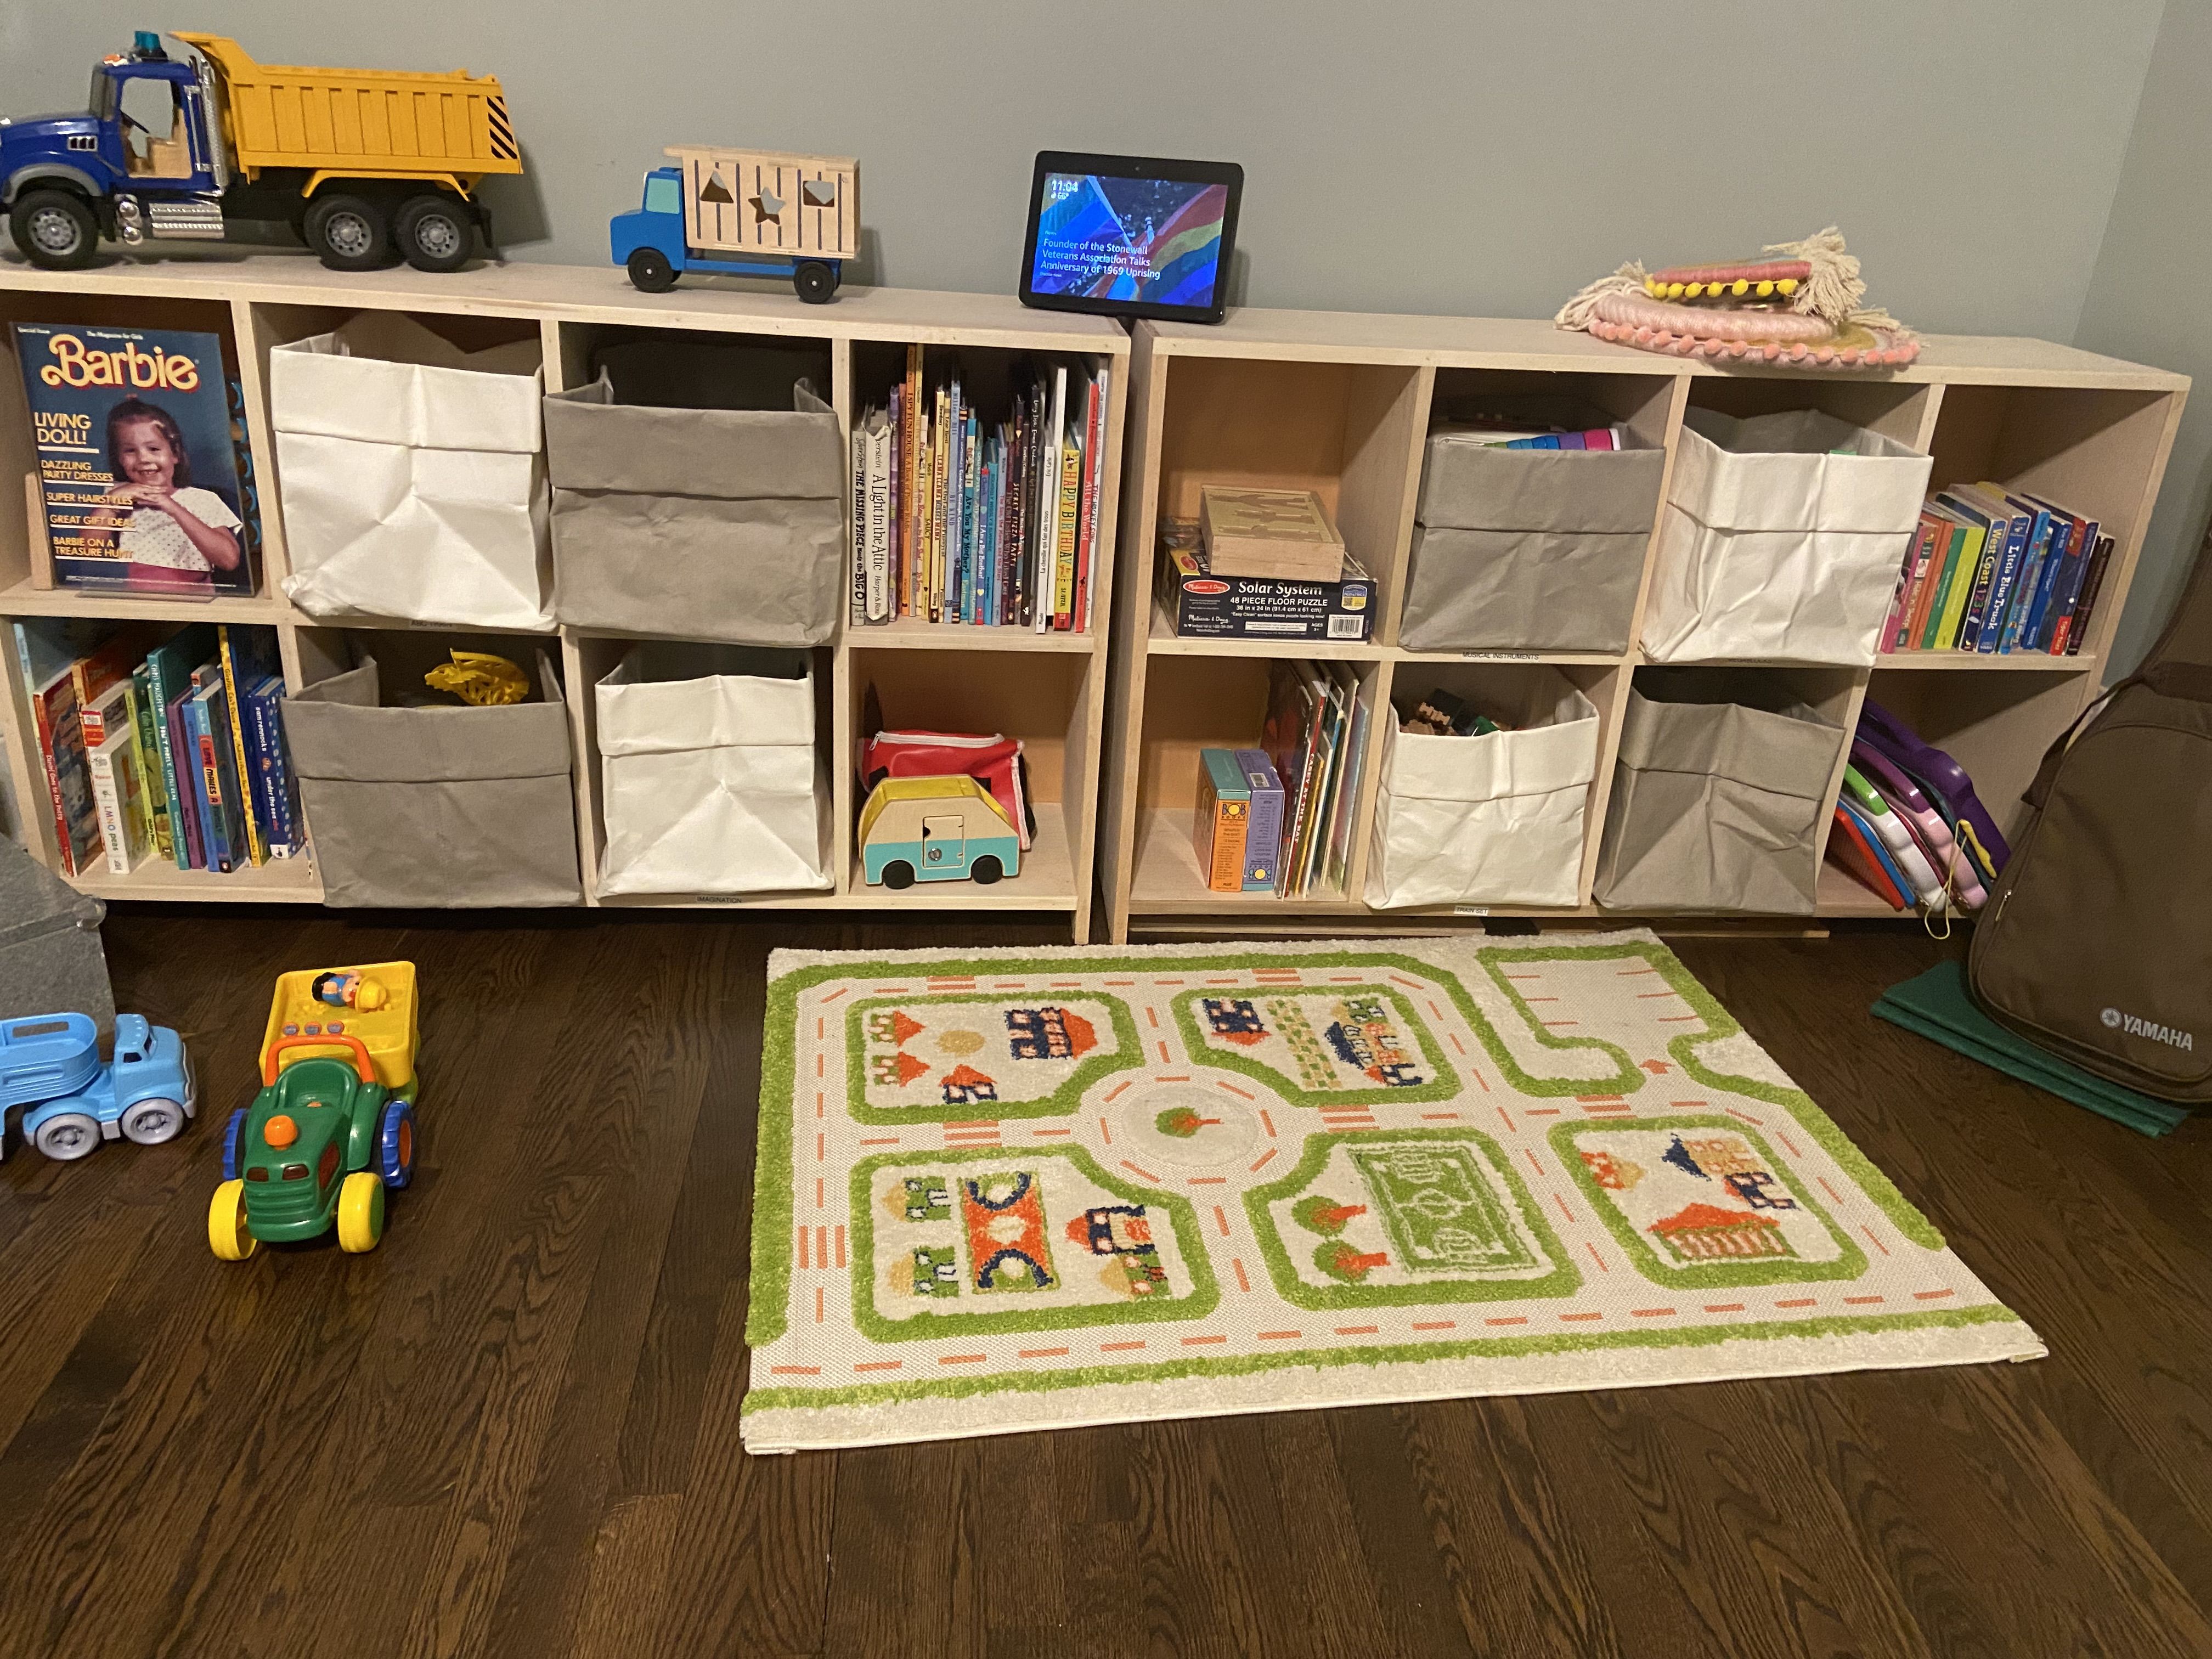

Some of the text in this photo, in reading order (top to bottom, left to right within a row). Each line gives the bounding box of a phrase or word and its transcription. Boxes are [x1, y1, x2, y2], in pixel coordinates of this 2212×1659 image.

[1052, 179, 1078, 192] 11:04
[1044, 239, 1148, 255] Founder of the Stonewall
[1042, 250, 1150, 266] Veterans Association Talks
[1041, 261, 1089, 274] Anniversary
[1103, 267, 1124, 275] 1969
[1126, 268, 1160, 280] Uprising
[41, 334, 198, 390] Barbie
[34, 412, 91, 430] LIVING
[37, 428, 86, 444] DOLL!
[41, 460, 92, 470] DAZZLING
[43, 470, 114, 481] PARTY DRESSES
[855, 471, 864, 486] THE
[873, 475, 886, 483] A
[47, 492, 133, 505] SUPER HAIRSTYLES
[855, 489, 865, 521] MISSING
[870, 486, 887, 512] Light
[50, 515, 106, 524] GREAT GIFT
[873, 514, 886, 526] in
[1059, 471, 1077, 565] HAPPY BIRTHDAY
[855, 523, 865, 546] PIECE
[873, 527, 885, 544] the
[962, 528, 970, 540] My
[980, 528, 985, 539] Am
[1082, 514, 1091, 540] World
[53, 537, 114, 548] BARBIE ON A
[55, 546, 102, 556] TREASURE
[873, 545, 887, 570] Attic
[1978, 527, 2002, 586] West Coast
[855, 573, 865, 589] BIG
[873, 575, 882, 596] Harper
[1239, 581, 1322, 597] Solar System
[1987, 544, 2019, 631] Little Blue Truck
[855, 591, 866, 600] O
[150, 664, 159, 680] CHRIS
[153, 682, 165, 717] HAUGHTON
[159, 725, 168, 744] DON'T
[45, 754, 54, 772] Daniel
[202, 746, 212, 765] LOVE
[256, 720, 267, 752] rennocks
[265, 776, 273, 795] under
[1305, 753, 1314, 785] CASEY
[49, 772, 57, 786] Goes
[205, 768, 217, 795] MAKES
[1301, 787, 1308, 800] AT
[54, 804, 64, 821] Potty
[1222, 804, 1246, 816] BOB
[1297, 803, 1306, 822] THE
[104, 805, 119, 851] LMNO peas
[2124, 1014, 2193, 1052] YAMAHA
